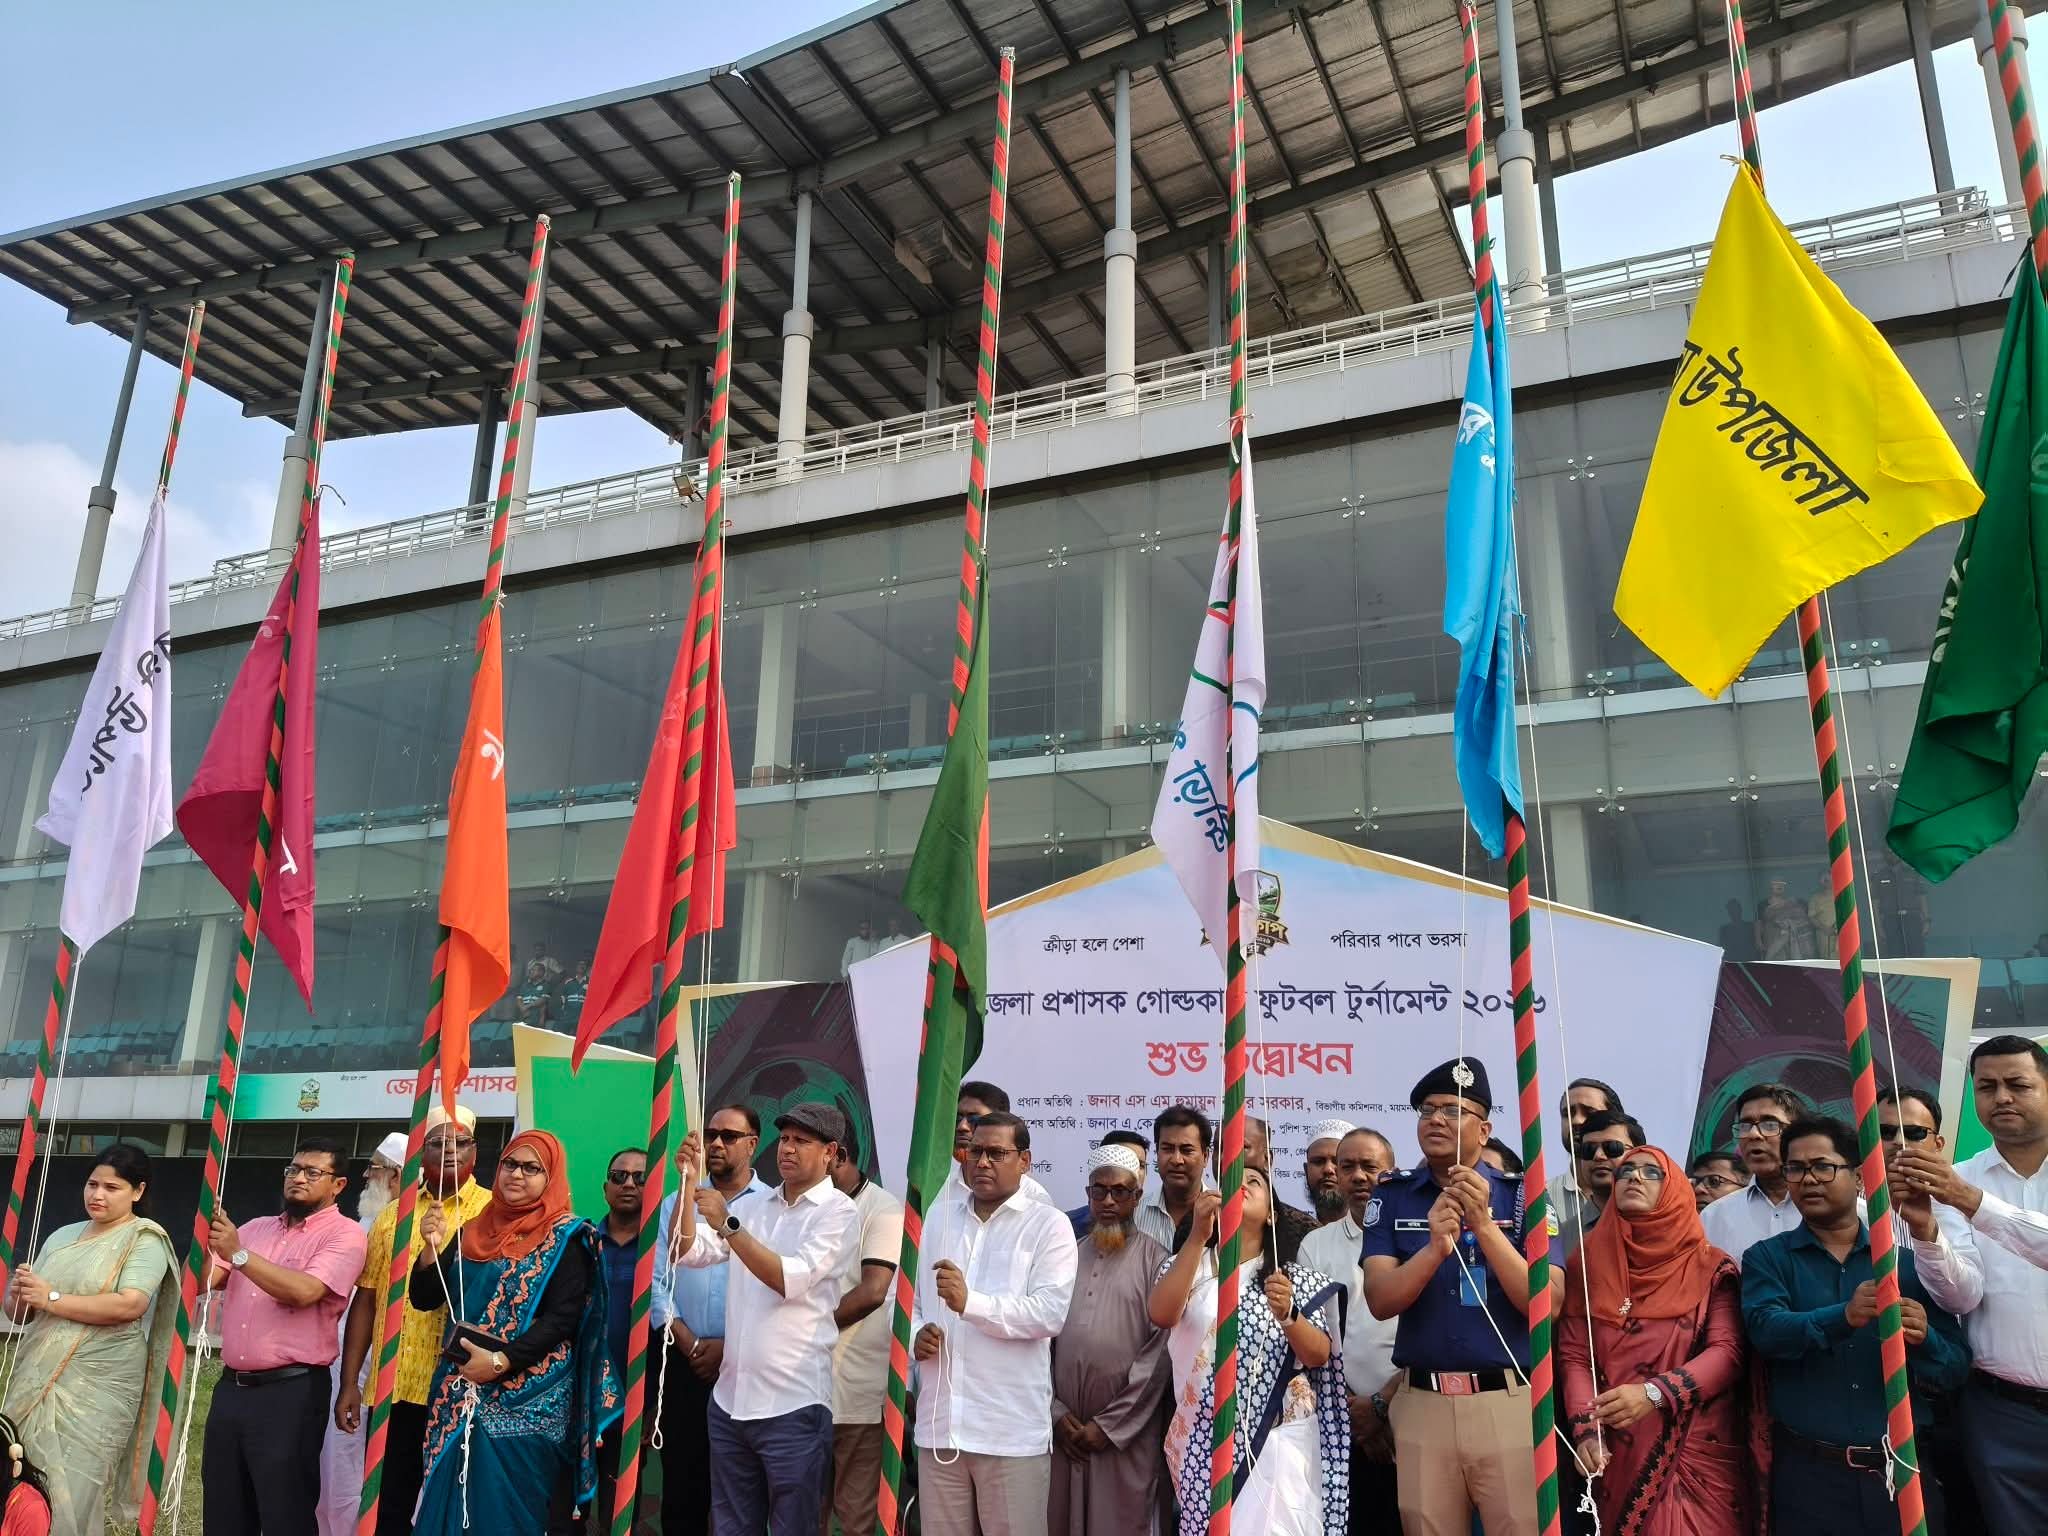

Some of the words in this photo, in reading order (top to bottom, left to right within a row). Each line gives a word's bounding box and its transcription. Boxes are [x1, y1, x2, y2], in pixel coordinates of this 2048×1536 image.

[1679, 346, 1870, 516] উপজেলা
[1042, 934, 1078, 954] ক্রীড়া
[1081, 937, 1107, 952] হলে
[1113, 936, 1145, 951] পেশা
[1330, 929, 1381, 949] পরিবার
[1387, 933, 1421, 948] পাবে
[1042, 988, 1128, 1017] প্রশাসক
[1137, 987, 1247, 1017] গোল্ডকা
[1255, 981, 1337, 1022] ফুটবল
[1344, 980, 1452, 1023] টুর্নামেন্ট
[1146, 1042, 1209, 1077] শুভ
[1017, 1096, 1041, 1108] প্রধান
[1043, 1094, 1073, 1108] অতিথি
[1087, 1094, 1121, 1108] জনাব
[1126, 1095, 1147, 1108] এস
[1151, 1095, 1172, 1109] এম
[1047, 1115, 1077, 1129] অতিথি
[1086, 1117, 1118, 1132] জনাব
